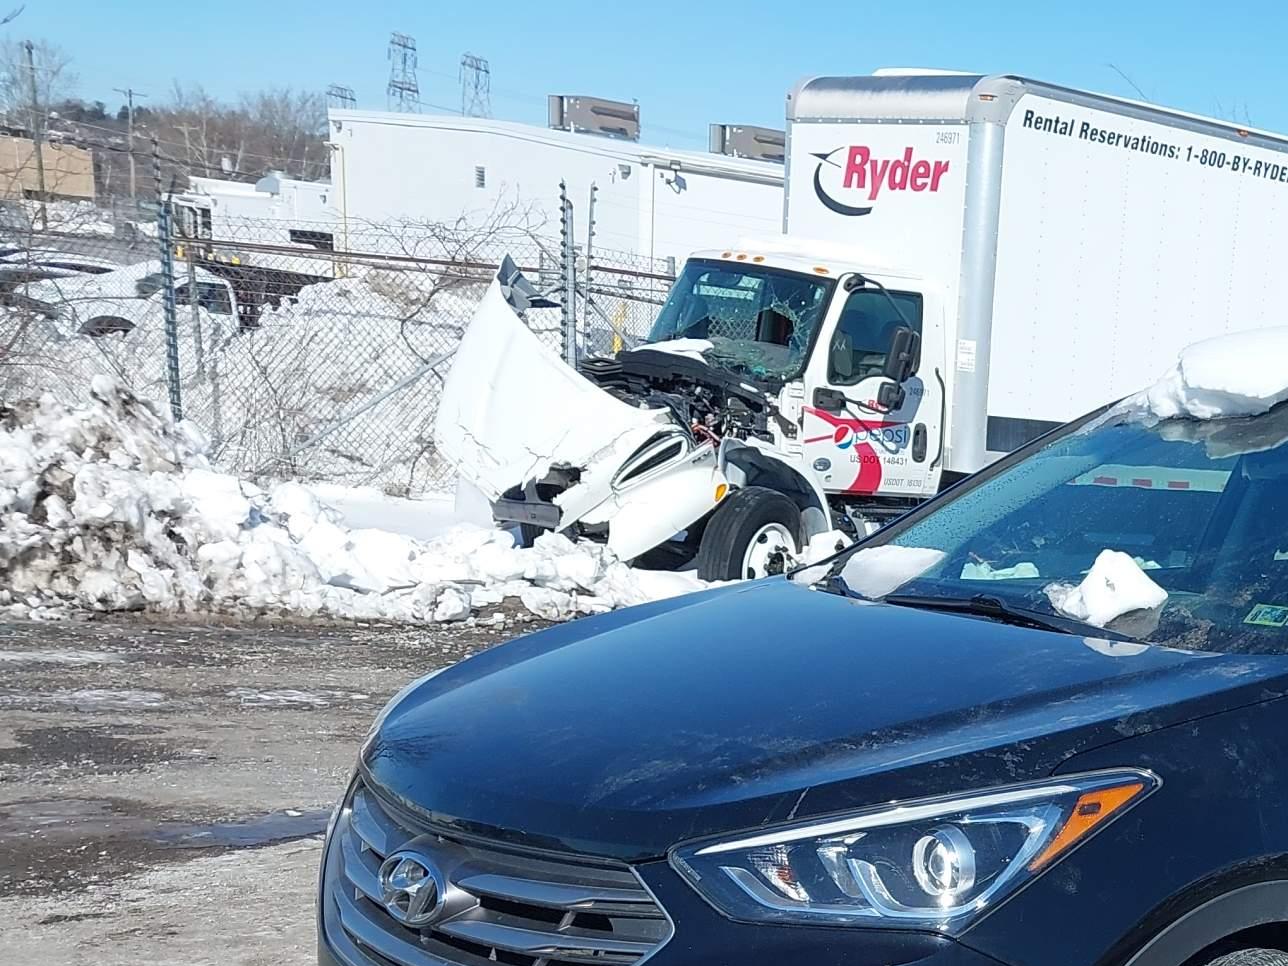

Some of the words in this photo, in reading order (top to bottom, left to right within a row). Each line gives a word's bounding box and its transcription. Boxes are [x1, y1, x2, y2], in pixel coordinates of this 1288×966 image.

[935, 131, 960, 145] 246971
[1022, 109, 1075, 137] Rental
[1078, 121, 1180, 159] Reservations:
[842, 145, 950, 201] Ryder
